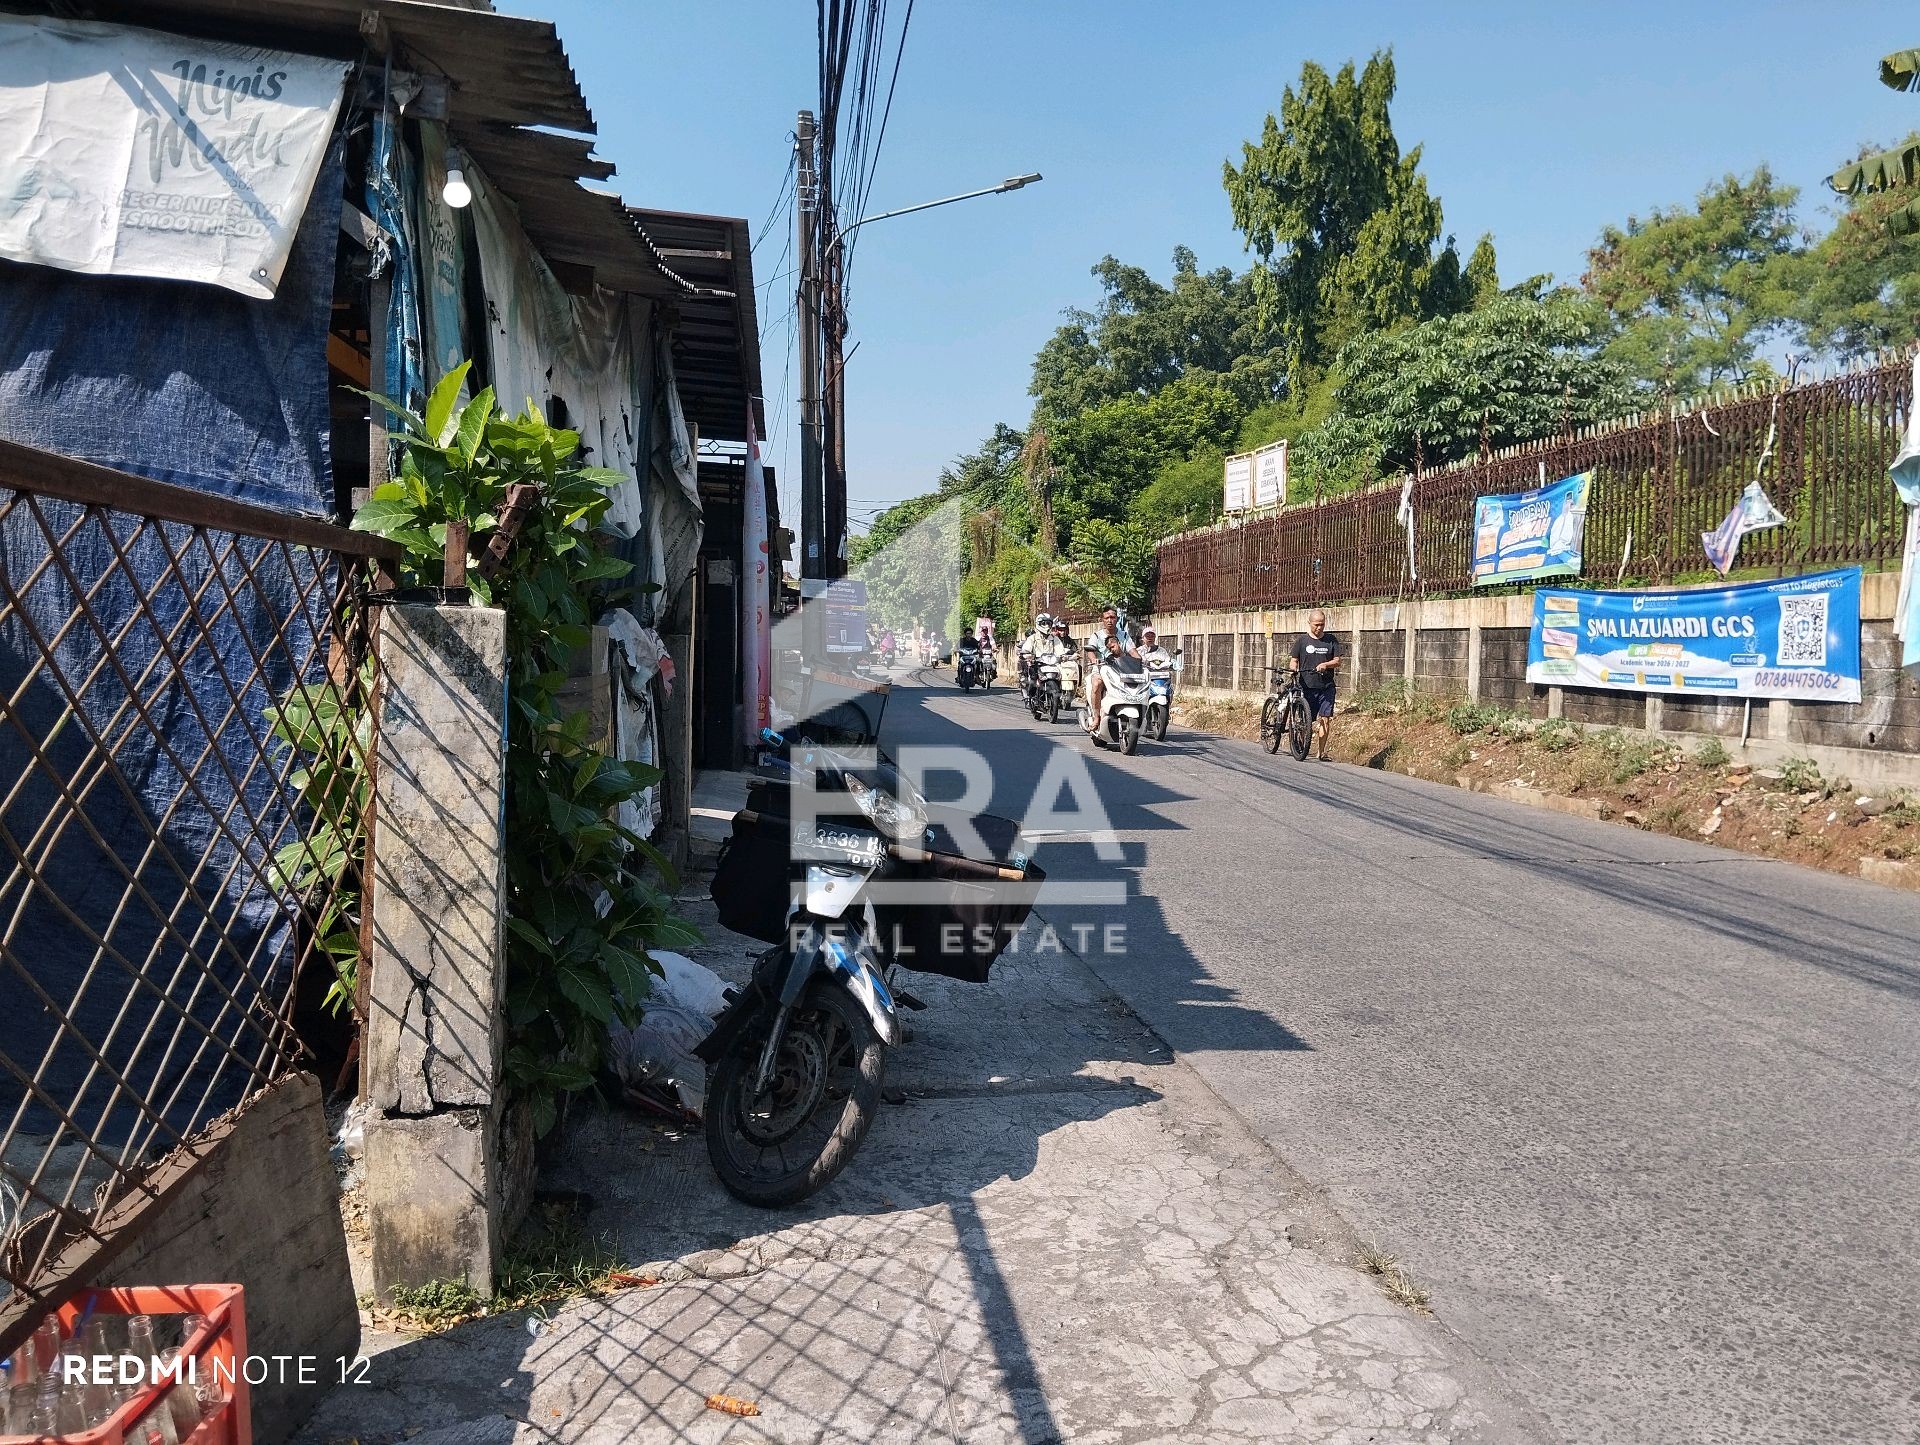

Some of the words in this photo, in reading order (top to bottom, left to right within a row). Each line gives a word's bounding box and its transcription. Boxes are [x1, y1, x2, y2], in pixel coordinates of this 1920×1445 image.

[172, 59, 287, 121] Nipis
[140, 112, 290, 184] Madu
[1586, 618, 1618, 638] SMA
[1620, 616, 1708, 638] LAZUARDI
[1712, 615, 1755, 638] GCS
[1620, 658, 1643, 666] Academic
[1754, 671, 1840, 689] 087884475062
